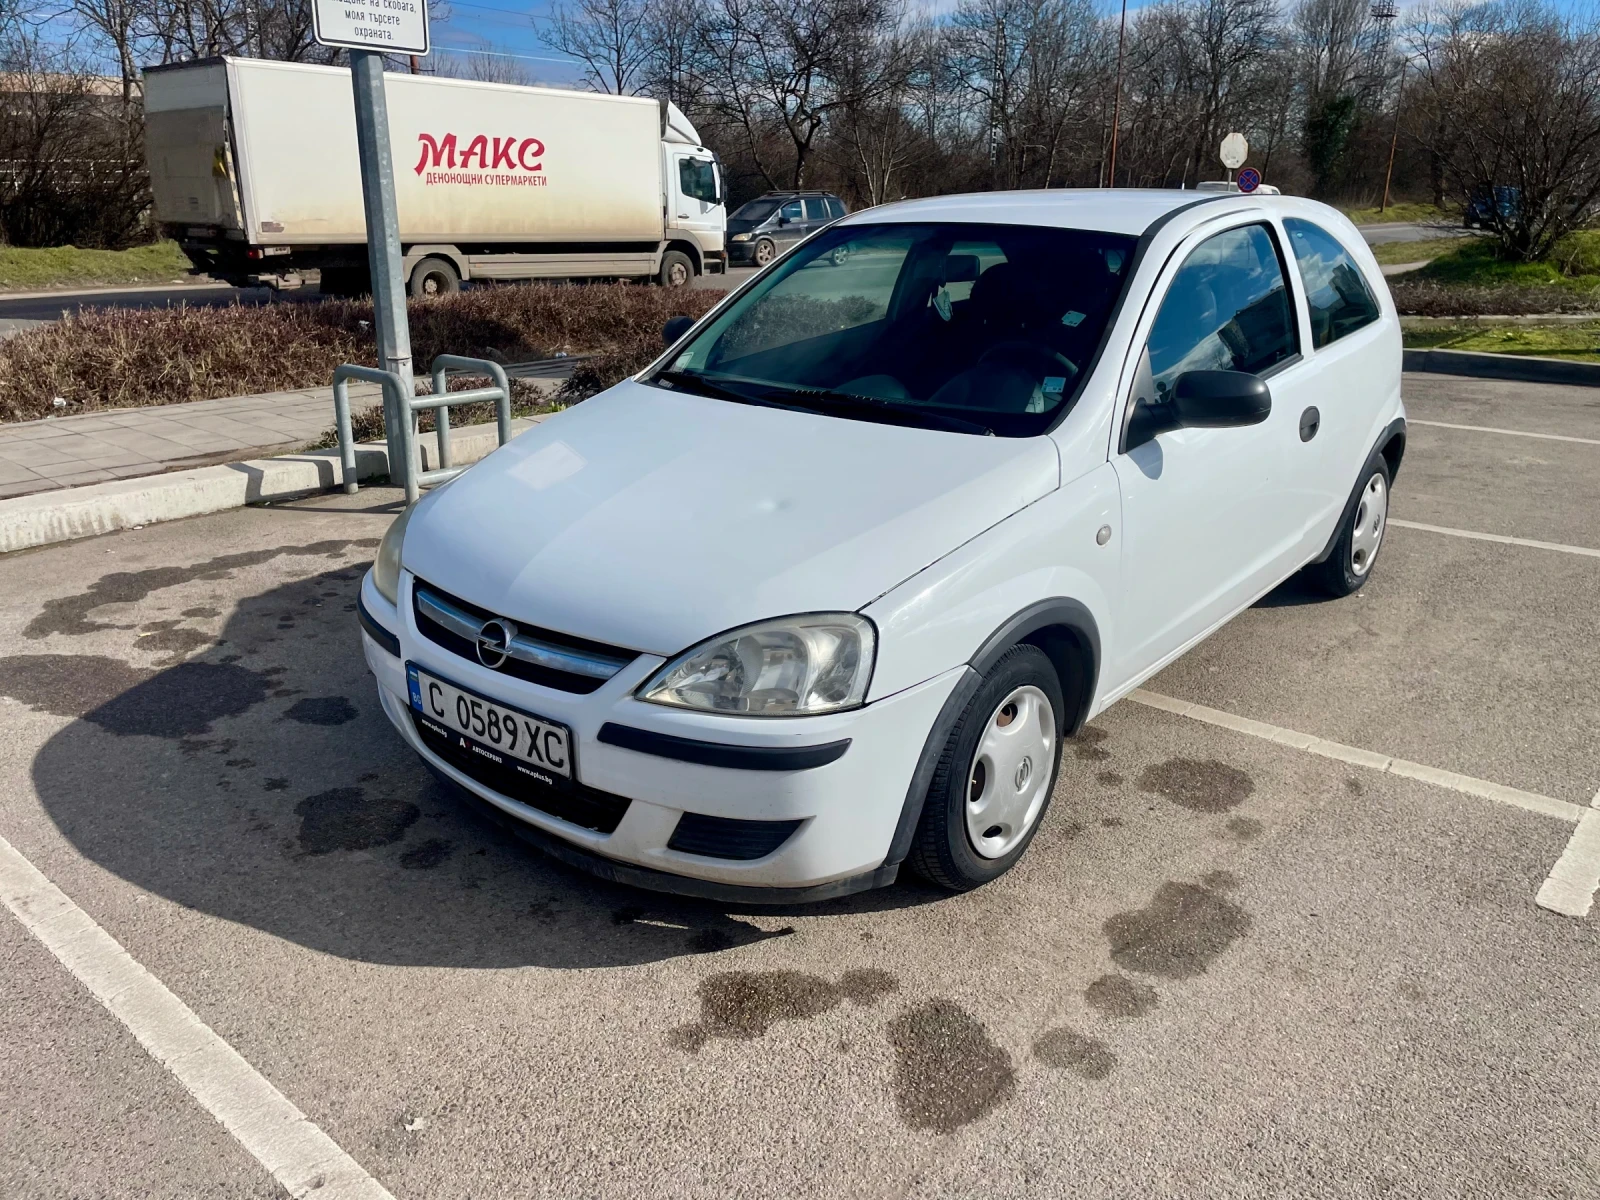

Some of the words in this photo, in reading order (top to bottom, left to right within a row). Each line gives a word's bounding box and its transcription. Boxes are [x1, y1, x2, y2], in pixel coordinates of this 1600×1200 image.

[344, 10, 365, 21] моля
[369, 13, 400, 26] търсете
[354, 27, 394, 40] охраната.
[413, 132, 545, 176] МАКС
[426, 172, 483, 186] ДЕНОНОЩНИ
[484, 174, 547, 187] СУПЕРМАРКЕТИ
[412, 692, 422, 705] BG
[456, 695, 518, 751] 0589
[516, 765, 553, 785] www.aplus.bg
